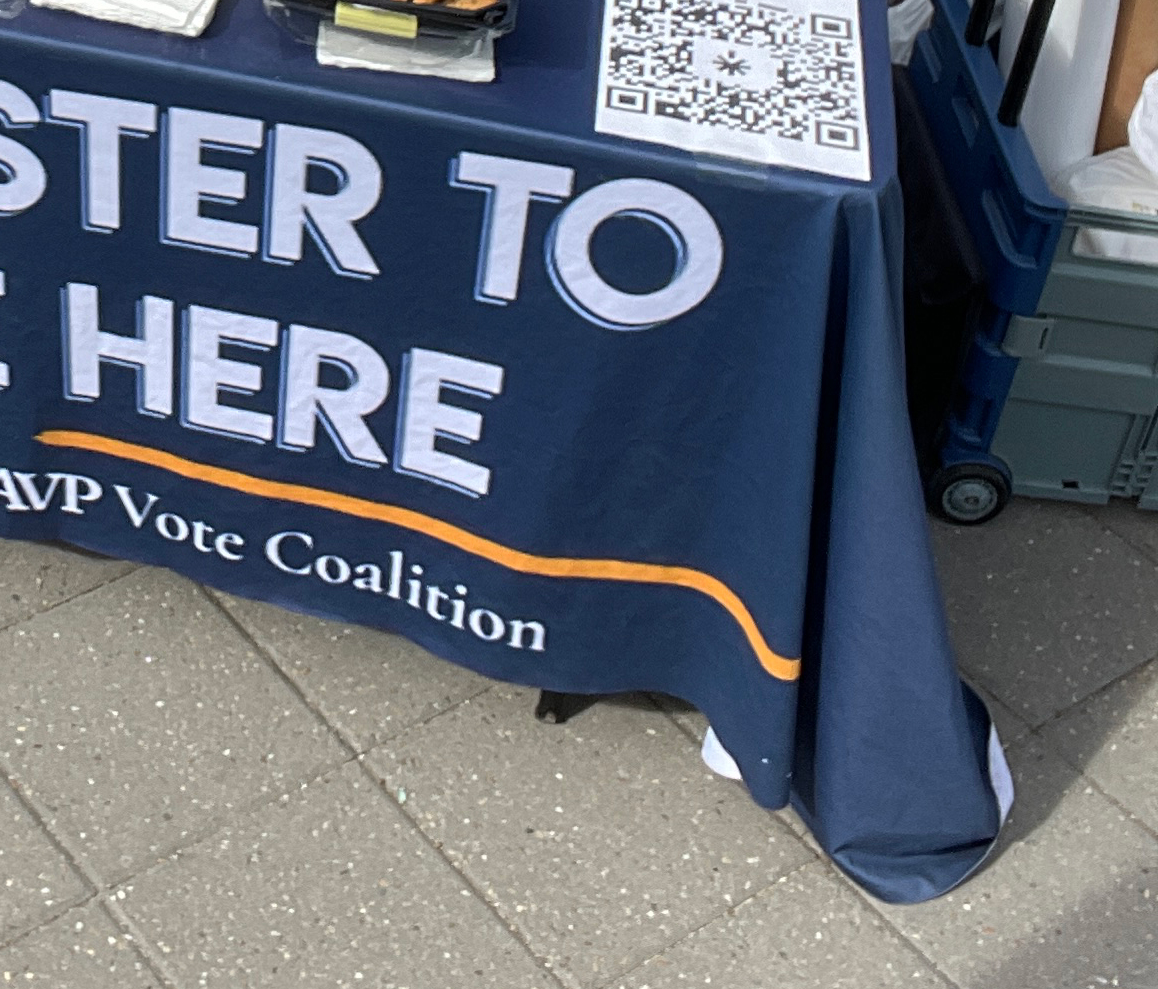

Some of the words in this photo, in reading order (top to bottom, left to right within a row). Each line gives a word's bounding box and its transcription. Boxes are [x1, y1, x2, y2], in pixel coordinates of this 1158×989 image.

[449, 151, 724, 330] TO
[60, 282, 505, 498] HERE
[112, 484, 245, 561] Vote
[266, 530, 546, 651] Coalition
